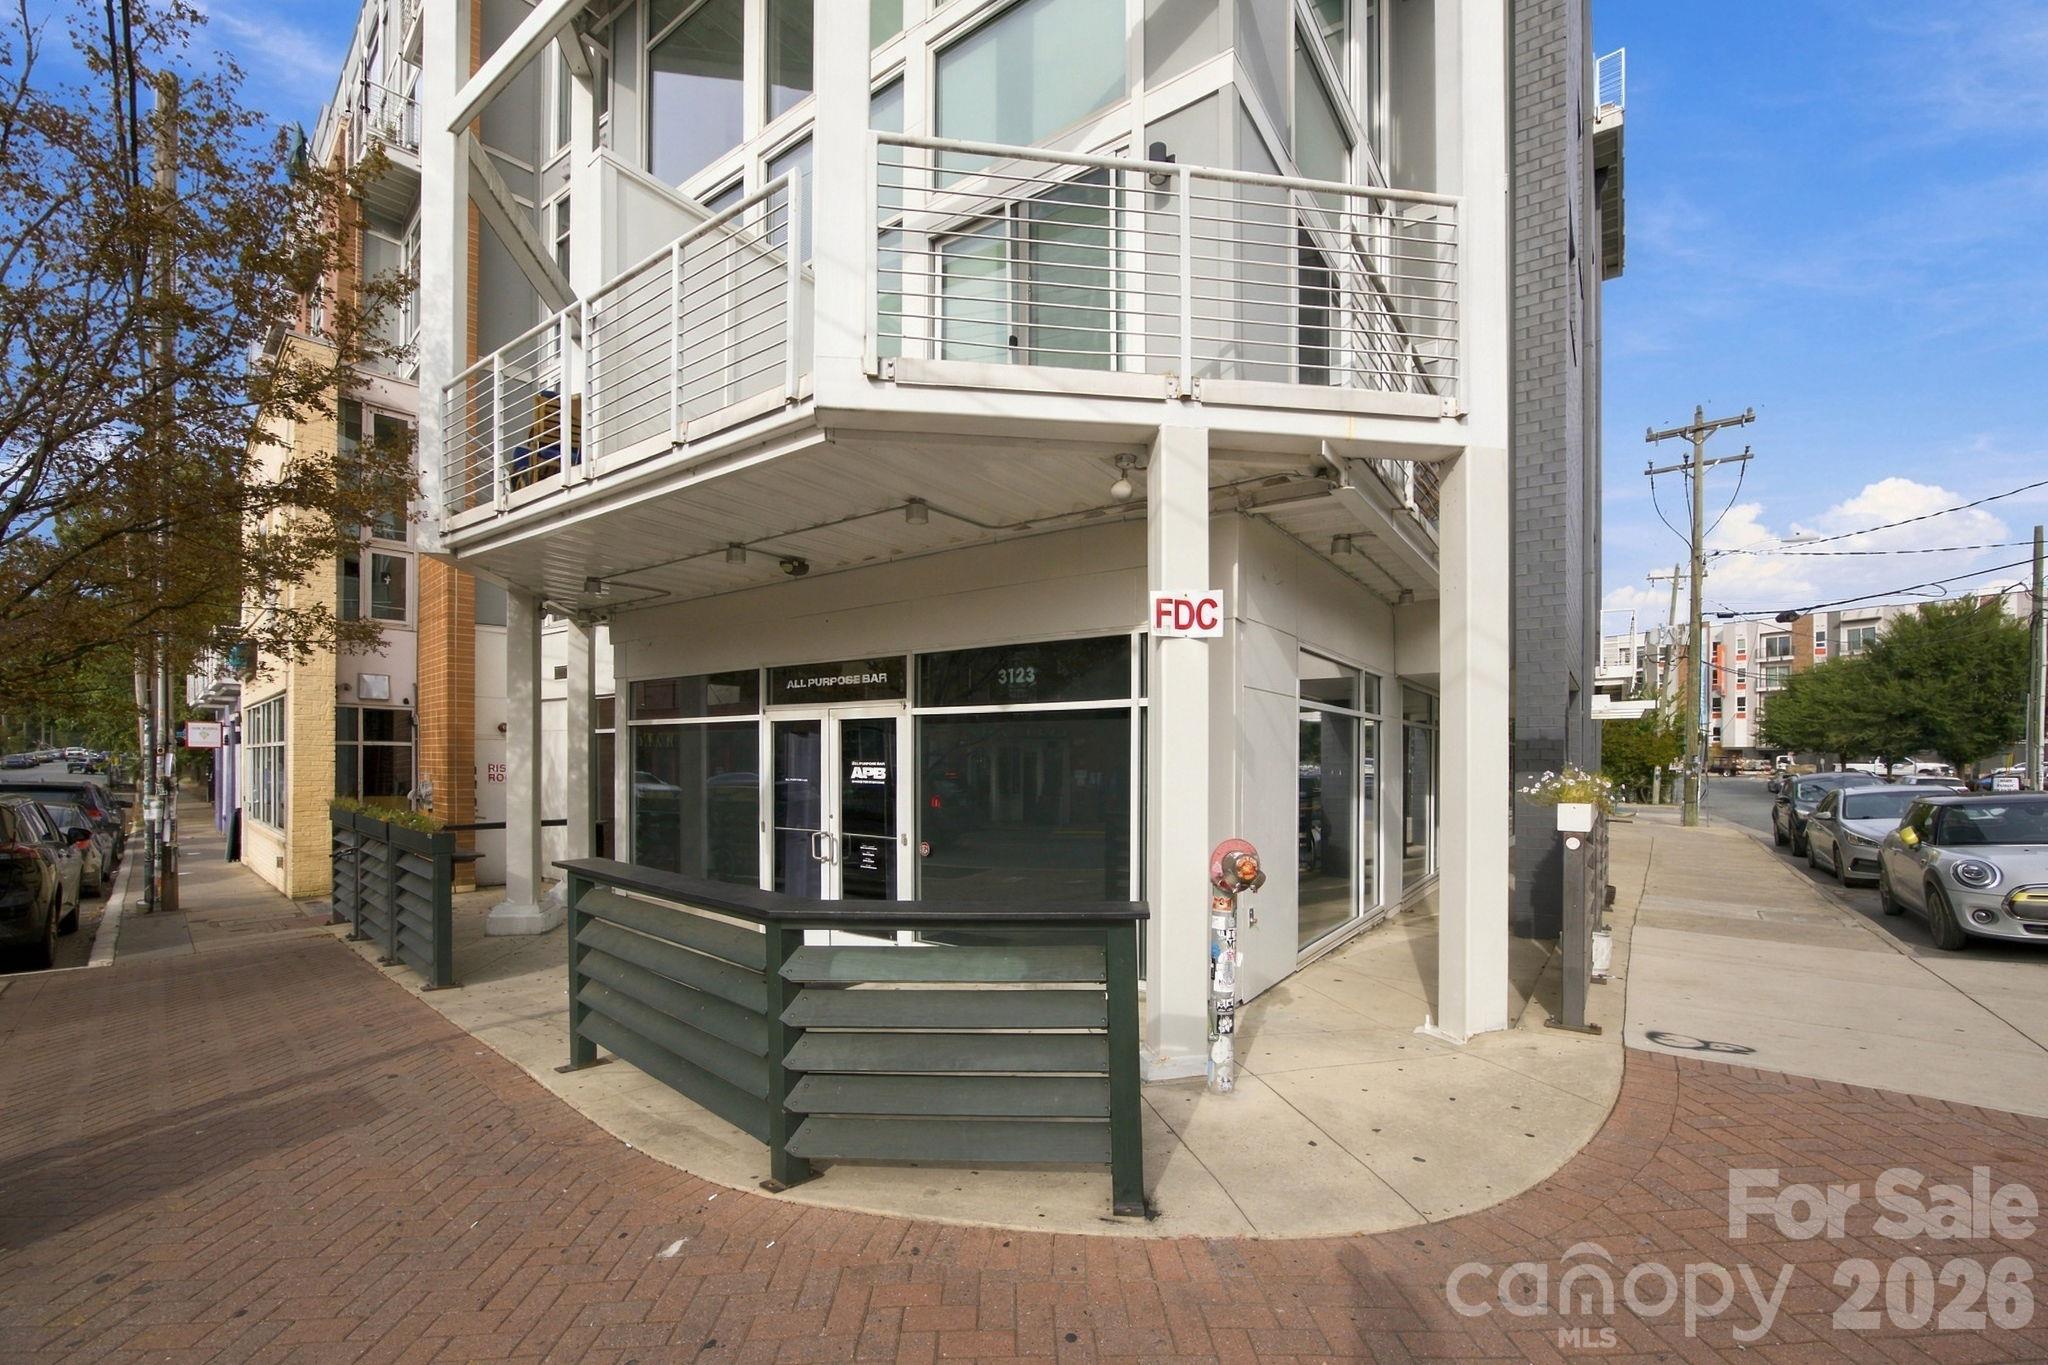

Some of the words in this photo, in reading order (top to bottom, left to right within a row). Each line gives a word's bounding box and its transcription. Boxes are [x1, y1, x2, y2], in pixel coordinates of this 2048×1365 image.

[1156, 598, 1218, 630] FDC
[786, 680, 807, 689] ALL
[807, 675, 861, 687] PURPOSE
[862, 673, 888, 683] BAR
[998, 667, 1036, 685] 3123
[488, 763, 507, 773] RIS
[851, 766, 887, 780] APB
[488, 773, 508, 782] RO
